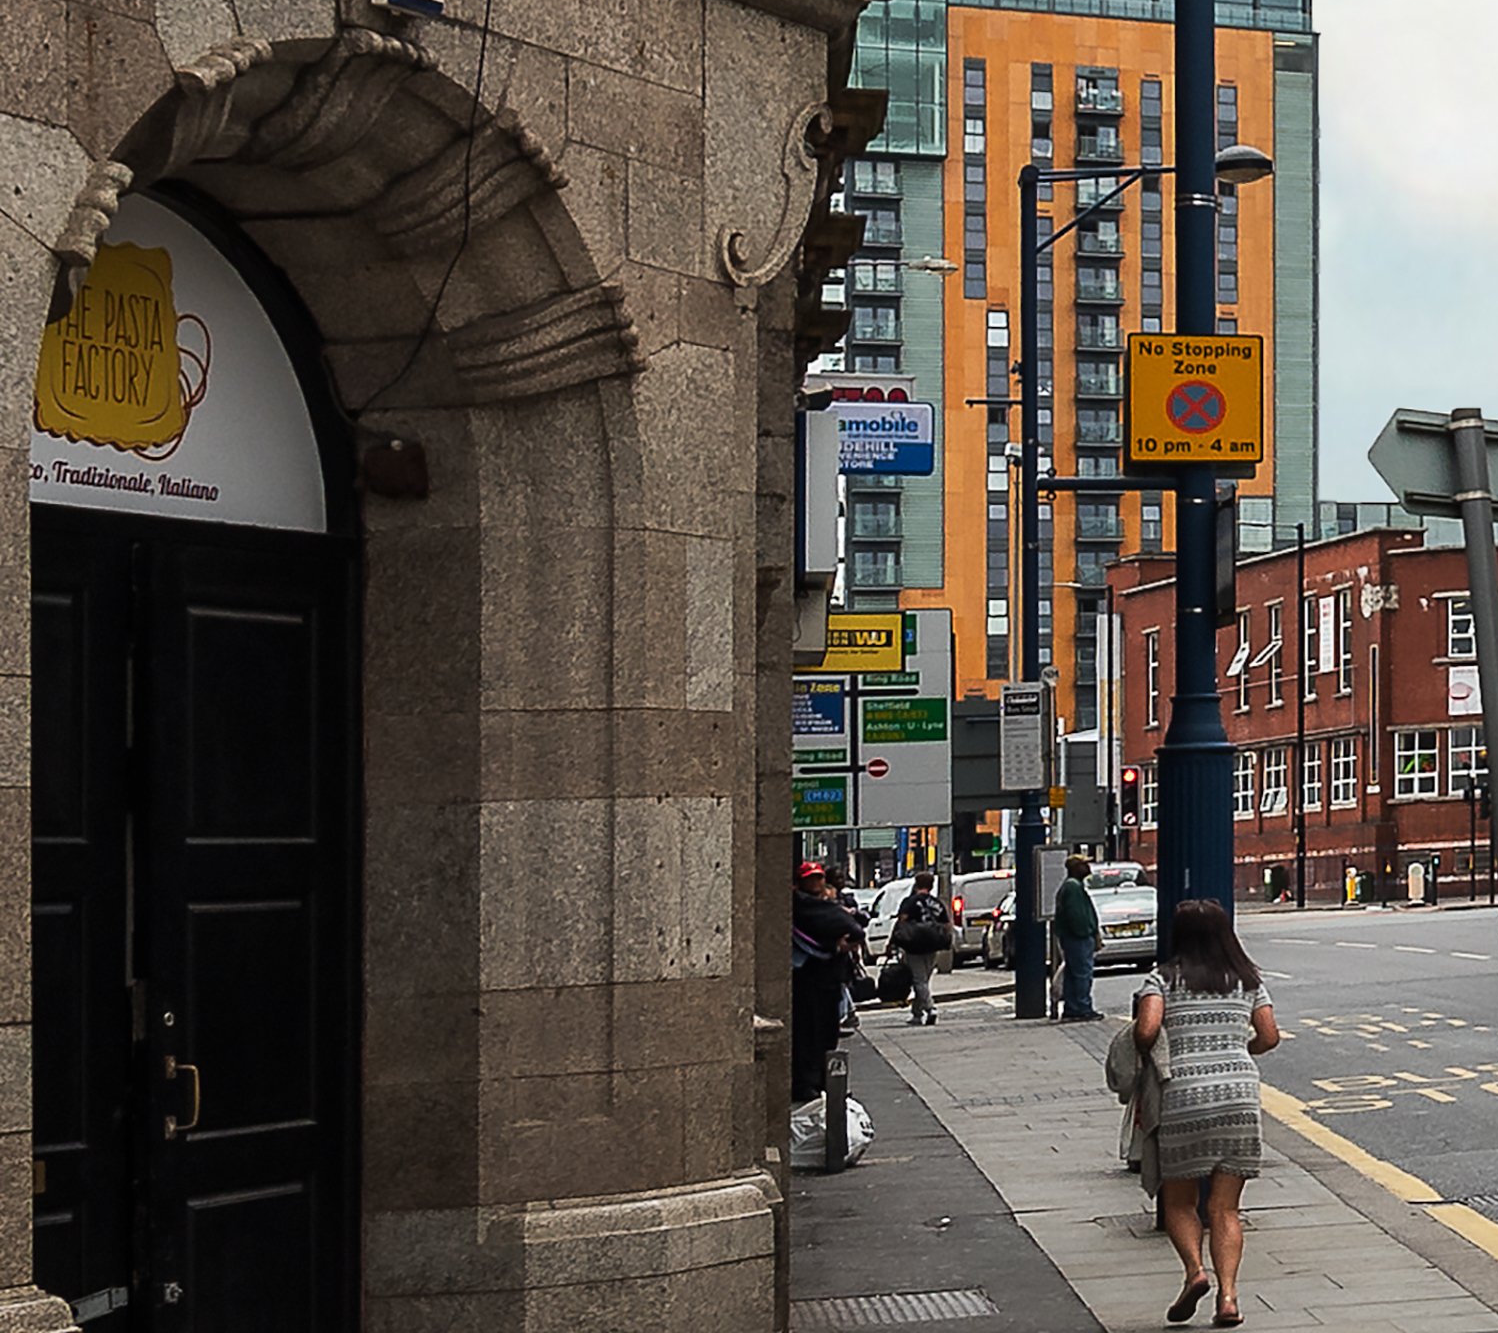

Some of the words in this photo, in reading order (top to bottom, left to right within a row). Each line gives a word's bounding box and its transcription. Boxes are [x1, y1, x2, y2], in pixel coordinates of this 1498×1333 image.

[104, 289, 163, 352] PASTA
[1139, 342, 1164, 355] No
[1172, 342, 1252, 359] Stopping
[62, 341, 154, 407] FACTORY
[1173, 360, 1217, 374] Zone
[1137, 438, 1157, 452] 10
[1164, 440, 1191, 455] pm
[1210, 438, 1222, 452] 4
[1230, 441, 1255, 452] am
[53, 460, 154, 495] Tradizionale,
[158, 473, 219, 501] Italiano
